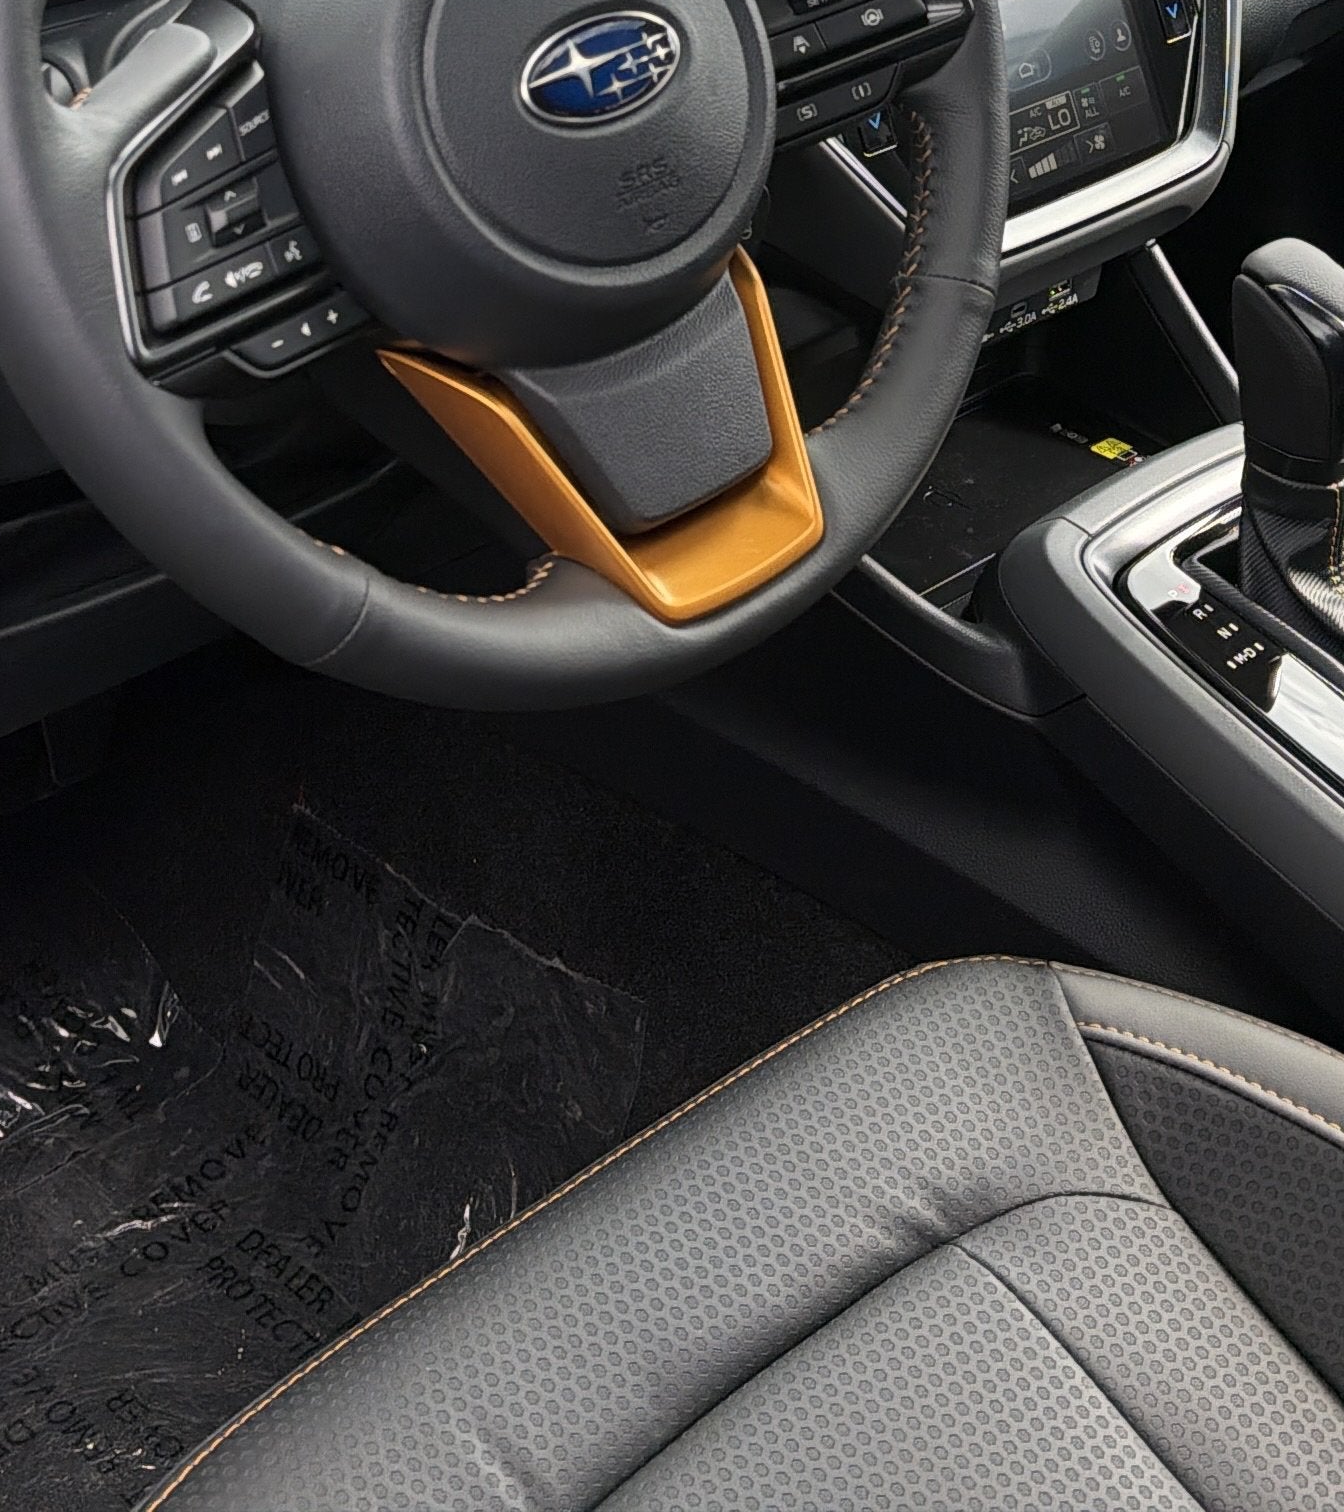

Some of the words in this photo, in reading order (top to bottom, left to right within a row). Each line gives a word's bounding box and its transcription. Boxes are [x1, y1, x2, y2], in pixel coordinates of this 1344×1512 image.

[1047, 108, 1072, 131] LO
[1192, 608, 1208, 620] R
[1216, 627, 1233, 640] N
[235, 1227, 336, 1315] DEALER
